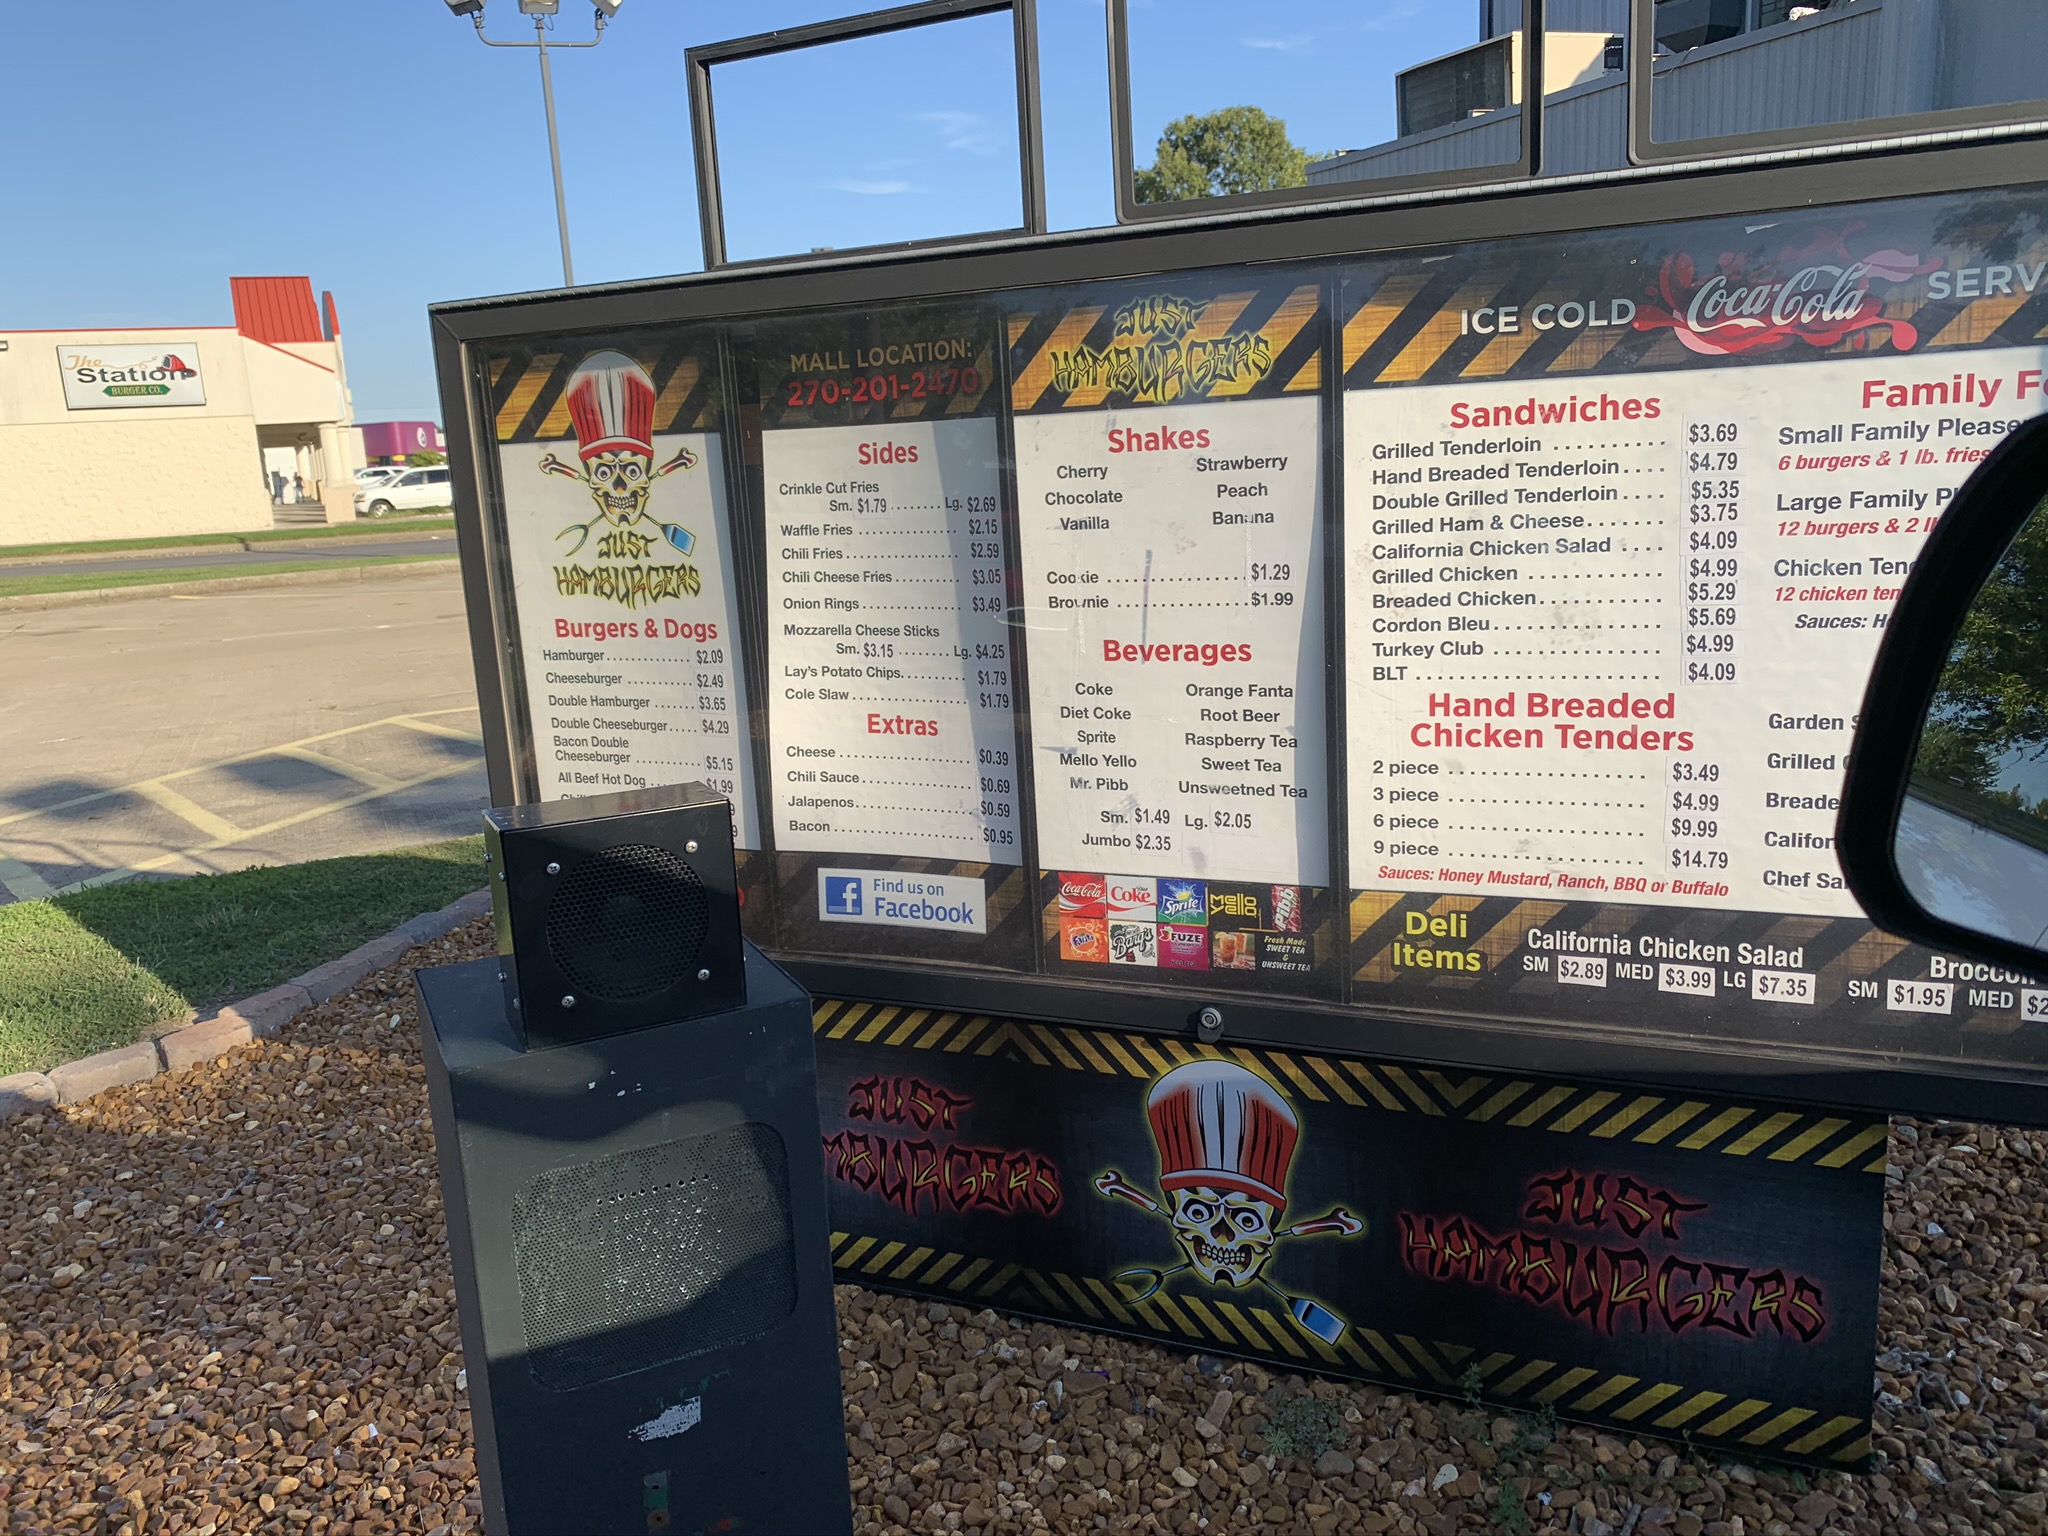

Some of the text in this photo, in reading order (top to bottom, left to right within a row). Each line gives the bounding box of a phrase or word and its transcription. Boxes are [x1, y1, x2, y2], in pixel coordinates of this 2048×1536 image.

[1460, 261, 2045, 335] ICE COLD Coca-Cola SERV
[1114, 296, 1209, 337] JUST
[65, 355, 102, 370] The
[791, 338, 972, 373] MALL LOCATION:
[77, 368, 190, 383] Station
[1050, 334, 1272, 402] HAMBURGERS
[111, 385, 163, 395] BURGER CO.
[787, 367, 979, 406] 270-201-2470
[1862, 373, 2002, 409] Family
[1450, 394, 1661, 429] Sandwiches
[1108, 425, 1211, 453] Shakes
[1372, 423, 1738, 459] Grilled Tenderloin $3.69
[1778, 421, 1930, 445] Small Family
[858, 441, 918, 465] Sides
[1196, 455, 1288, 472] Strawberry
[1778, 447, 1992, 471] 6 burgers & 1 lb. fries
[1057, 465, 1108, 480] Cherry
[1372, 452, 1738, 485] Hand Breaded Tenderloin $4.79
[779, 481, 879, 495] Crinkle Cut Fries
[1045, 490, 1123, 506] Chocolate
[1217, 483, 1268, 498] Peach
[829, 496, 996, 514] Sm. $1.79 Lg. $2.69
[1777, 489, 1928, 514] Large Family
[780, 519, 998, 536] Waffle Fries $2.15
[1060, 517, 1110, 530] Vanilla
[1778, 518, 1919, 538] 12 burgers & 2
[597, 530, 658, 560] JUST
[1372, 531, 1738, 560] California Chicken Salad $4.09
[1774, 559, 1862, 577] Chicken
[553, 563, 701, 610] HAMBURGERS
[783, 597, 1001, 612] Onion Rings $3.49
[555, 618, 718, 642] Burgers & Dogs
[784, 624, 940, 637] Mozzarella Cheese Sticks
[543, 649, 723, 665] Hamburger $2.09
[1103, 640, 1252, 666] Beverages
[1372, 634, 1734, 659] Turkey Club $4.99
[546, 672, 723, 688] Cheeseburger $2.49
[1373, 662, 1736, 682] BLT $4.09
[1075, 682, 1113, 696] Coke
[1186, 684, 1293, 700] Orange Fanta
[549, 695, 726, 711] Double Hamburger $3.65
[1060, 706, 1131, 720] Diet Coke
[1428, 692, 1675, 719] Hand Breaded
[867, 713, 938, 737] Extras
[1200, 708, 1280, 722] Root Beer
[554, 736, 629, 748] Bacon Double
[1077, 730, 1116, 745] Sprite
[1185, 732, 1298, 750] Raspberry Tea
[1410, 723, 1694, 752] Chicken Tenders
[555, 750, 733, 771] Cheeseburger $5.15
[786, 746, 1008, 766] Cheese $0.39
[1060, 753, 1137, 768] Mello Yello
[787, 771, 1010, 793] Chili Sauce $0.69
[1373, 760, 1720, 783] 2 piece $3.49
[788, 796, 1010, 818] Jalapenos $0.59
[789, 820, 1013, 845] Bacon $0.95
[1082, 833, 1171, 851] Jumbo $2.35
[874, 879, 944, 896] Find us on
[1062, 882, 1102, 897] Coca-Cola
[1378, 866, 1729, 897] Sauces: Honey Mustard, Ranch, BBQ or Buffalo
[1111, 886, 1150, 902] Coke
[875, 897, 974, 924] Facebook
[1164, 898, 1199, 914] Sprite
[1405, 911, 1468, 939] Deli
[1171, 932, 1202, 942] FUZE
[1527, 928, 1804, 968] California Chicken Salad
[1266, 944, 1305, 954] SWEET TEA
[1393, 943, 1482, 972] Items
[1523, 957, 1807, 997] SM $2.89 MED $3.99 LG $7.35
[1848, 981, 2014, 1009] SM $1.95 MED
[849, 1075, 975, 1131] JUST
[1526, 1169, 1708, 1241] JUST
[1402, 1213, 1825, 1343] HAMBURGERS
